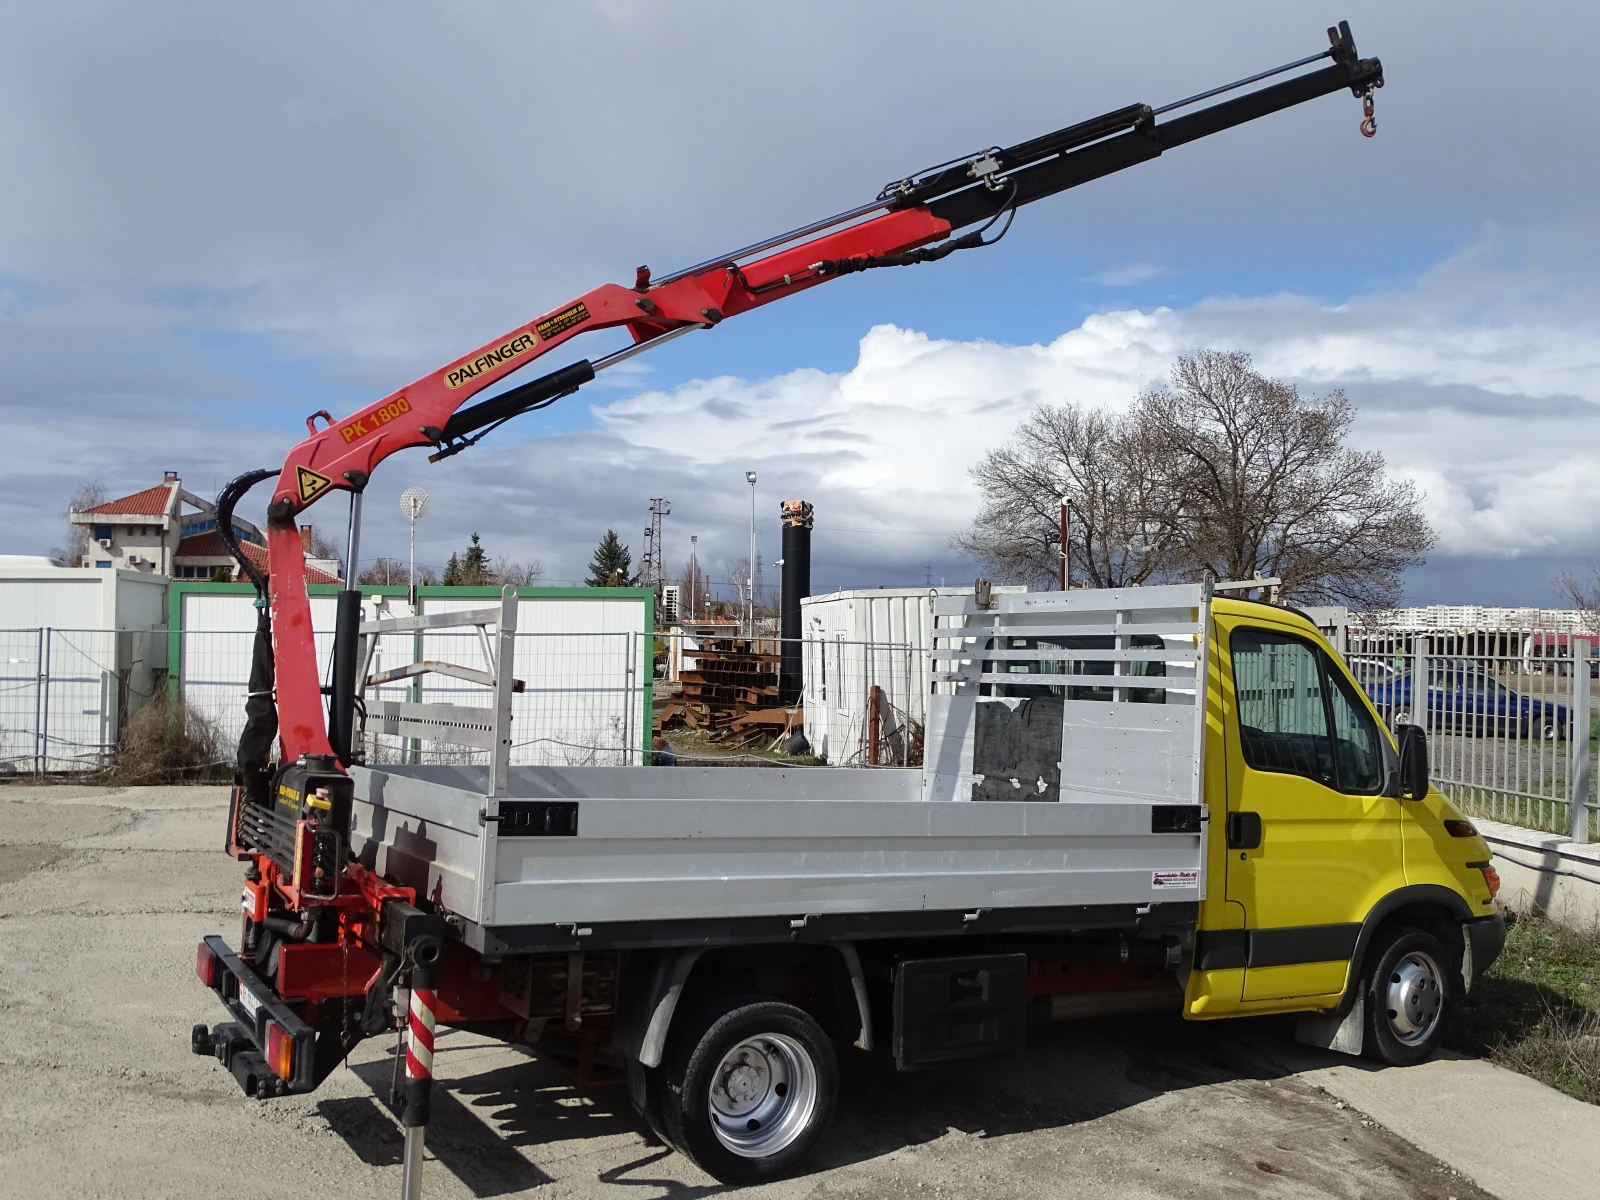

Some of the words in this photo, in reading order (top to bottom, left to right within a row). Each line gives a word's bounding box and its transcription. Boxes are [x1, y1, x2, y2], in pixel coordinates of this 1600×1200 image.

[447, 333, 535, 387] PALFINGER
[341, 420, 369, 443] PK
[369, 398, 410, 428] 1800
